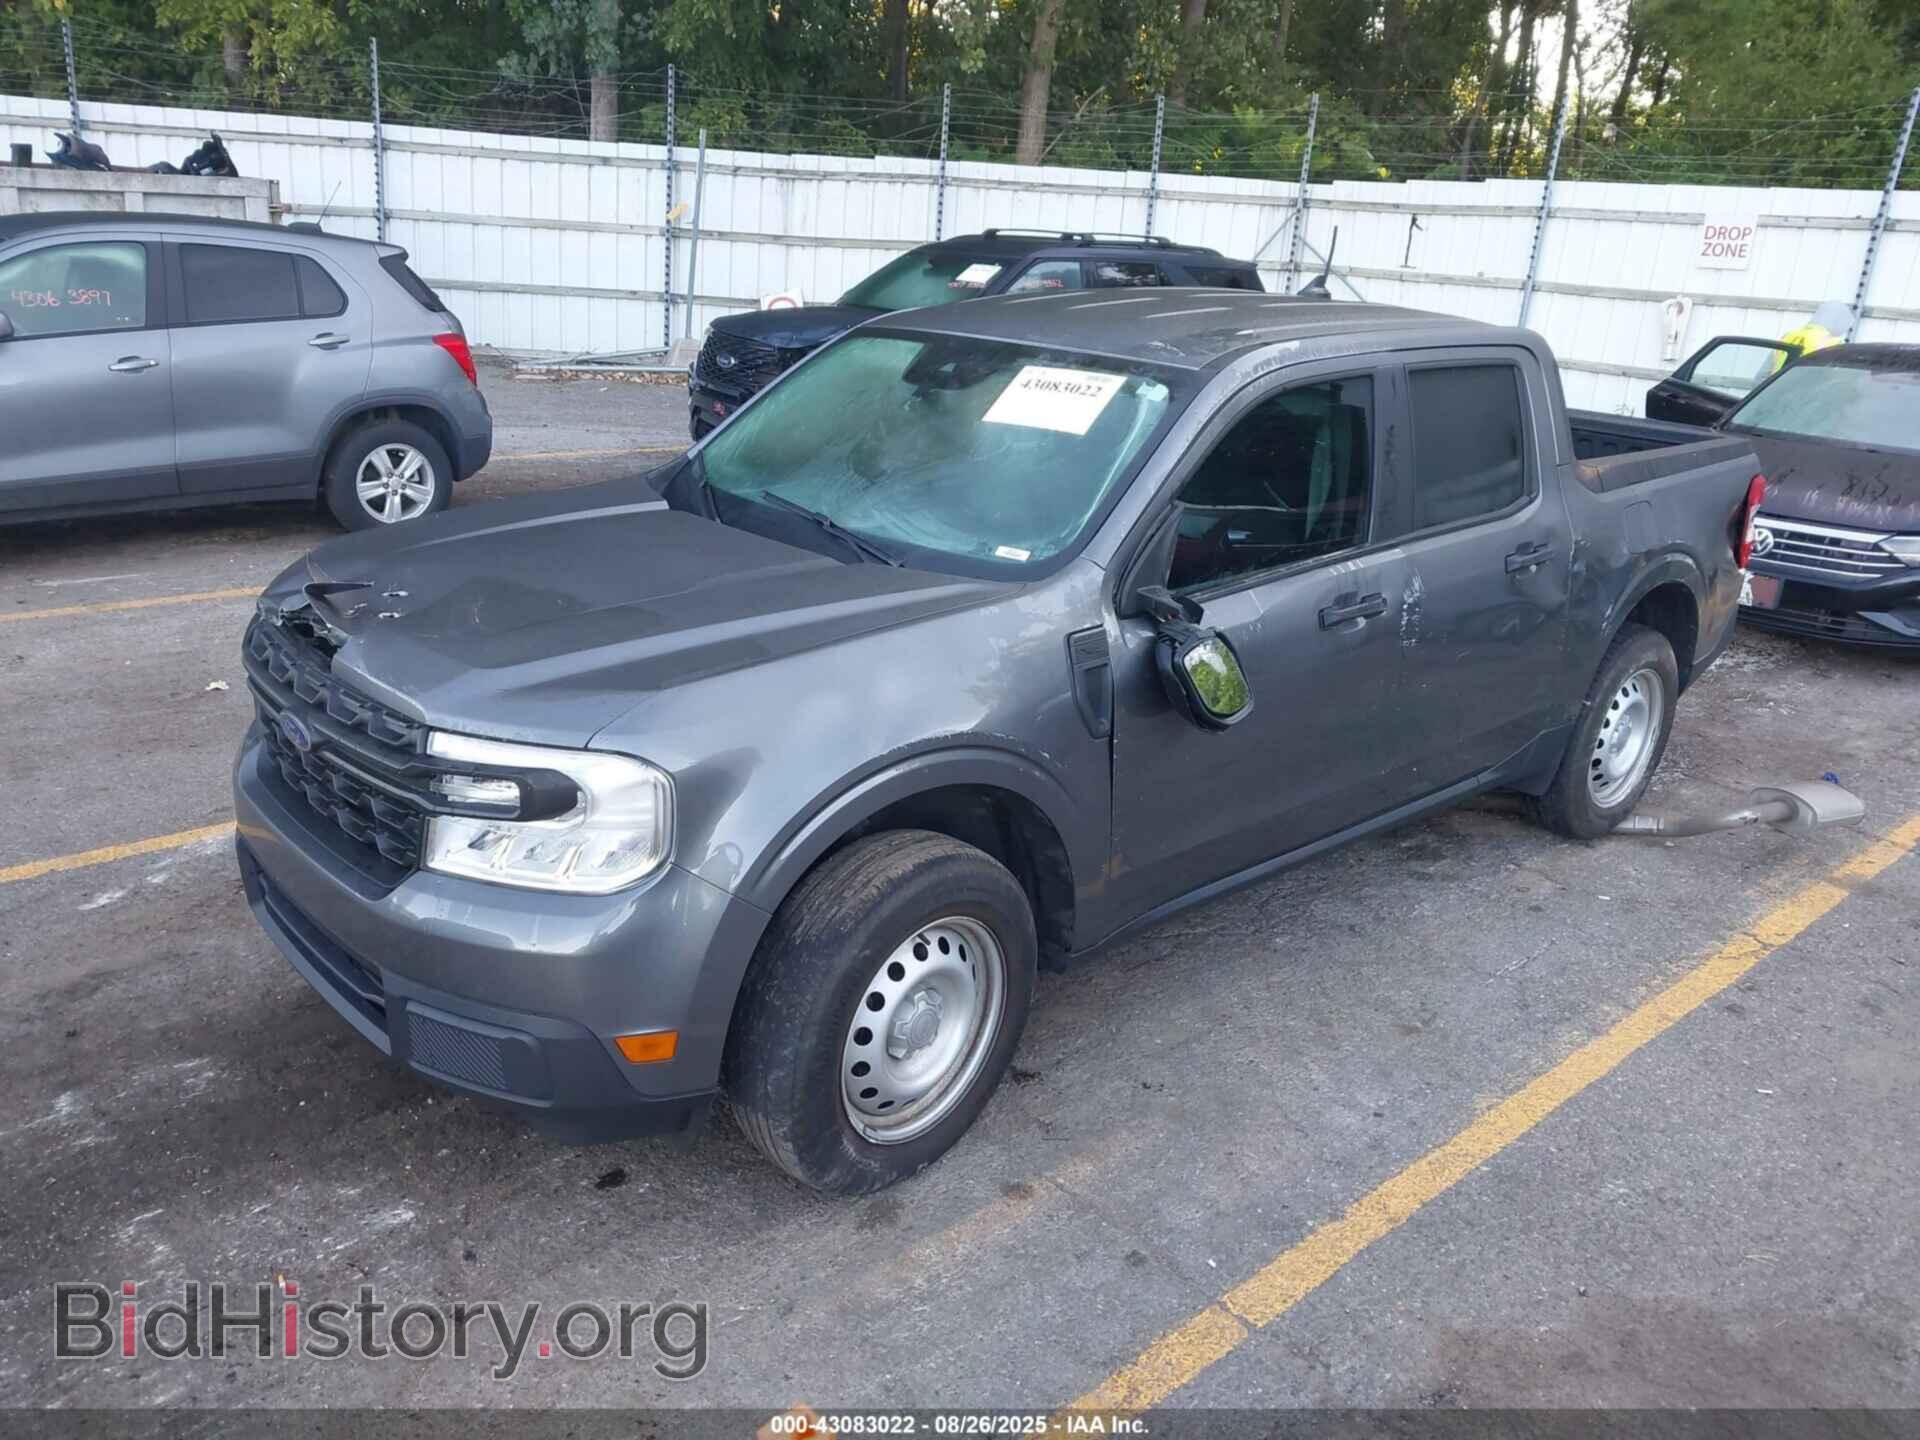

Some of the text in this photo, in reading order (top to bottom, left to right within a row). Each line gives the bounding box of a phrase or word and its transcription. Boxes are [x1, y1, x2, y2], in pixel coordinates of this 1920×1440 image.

[1704, 225, 1753, 241] DROP
[1701, 242, 1749, 258] ZONE
[1021, 378, 1103, 397] 43083022
